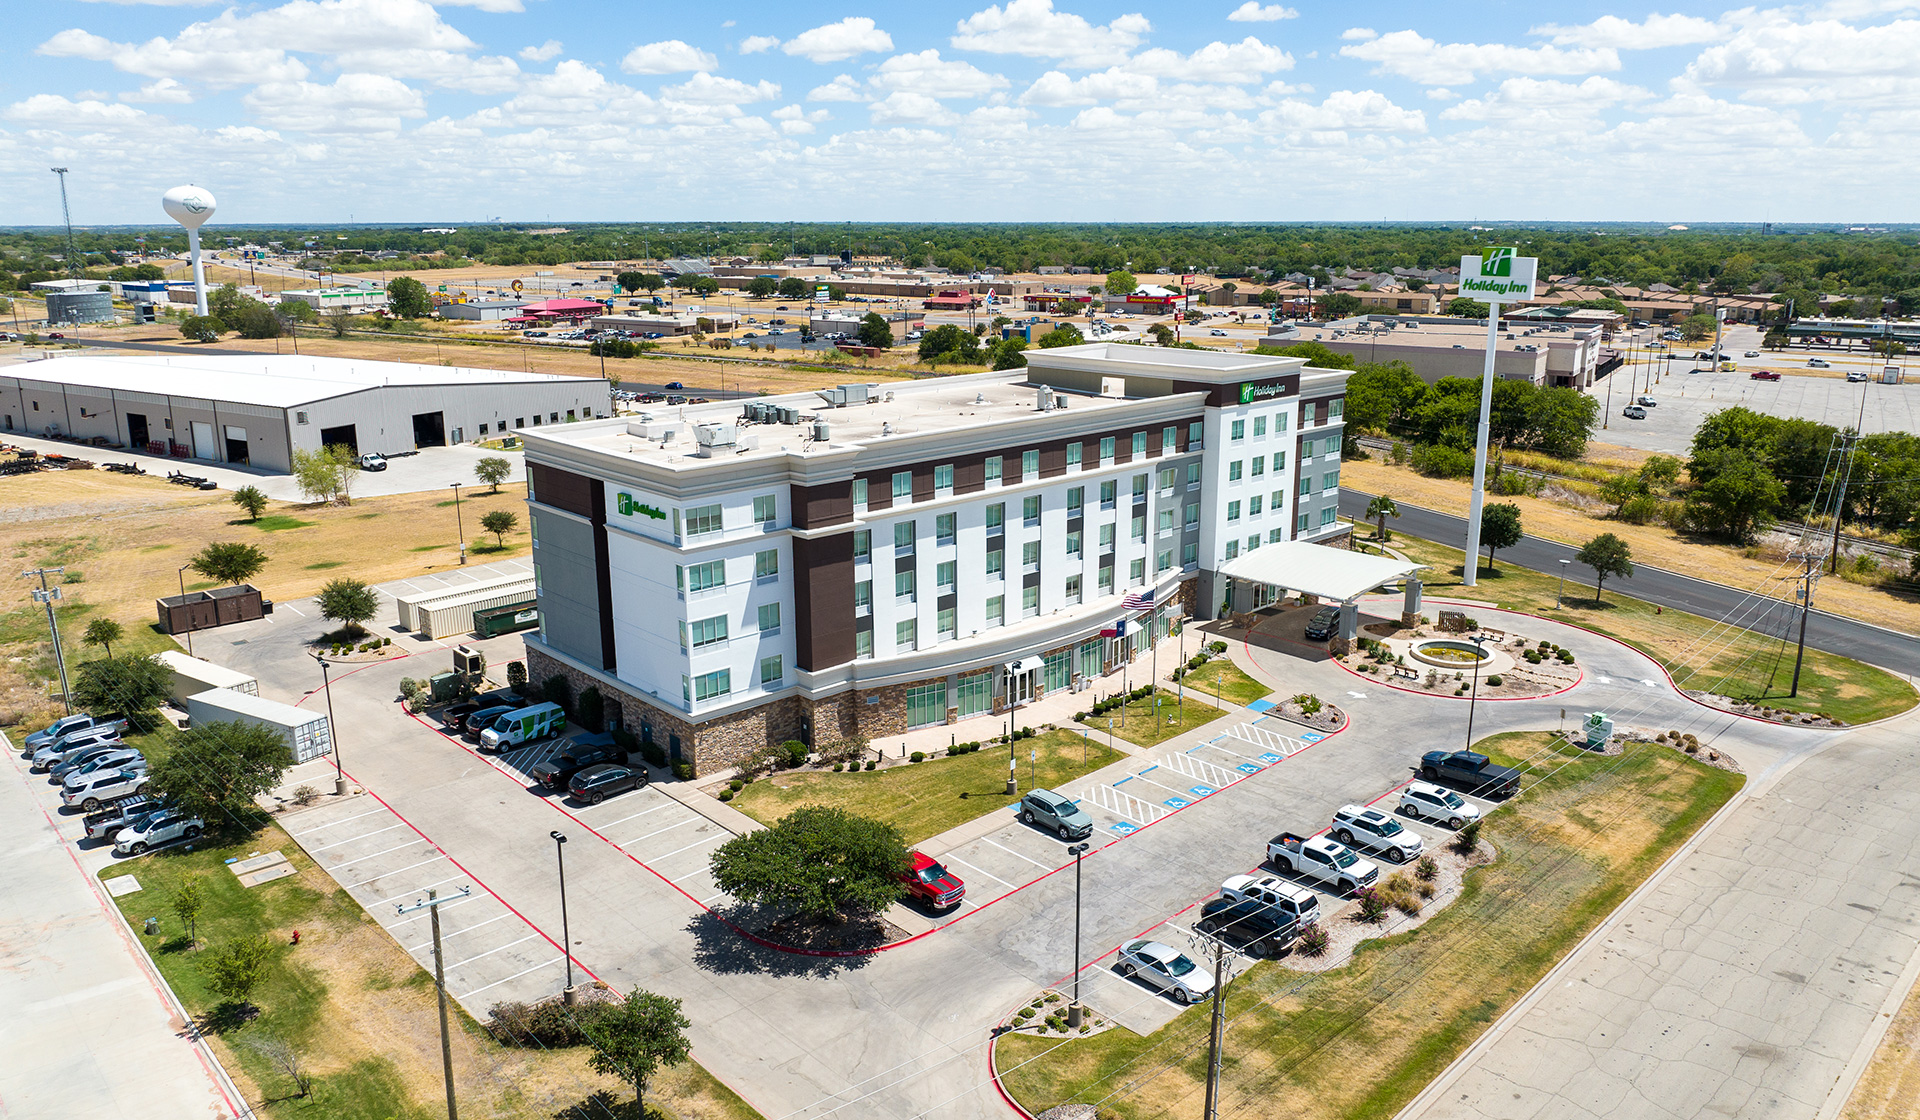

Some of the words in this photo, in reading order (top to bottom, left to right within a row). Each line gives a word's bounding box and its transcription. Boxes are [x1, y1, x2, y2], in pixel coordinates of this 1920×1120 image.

[1483, 249, 1511, 275] H
[1462, 278, 1508, 295] Holiday
[1508, 280, 1528, 293] Inn
[1243, 384, 1254, 401] H
[1253, 384, 1276, 397] Holiday
[1275, 383, 1286, 393] Inn
[618, 496, 629, 513] H
[632, 500, 656, 519] Holiday
